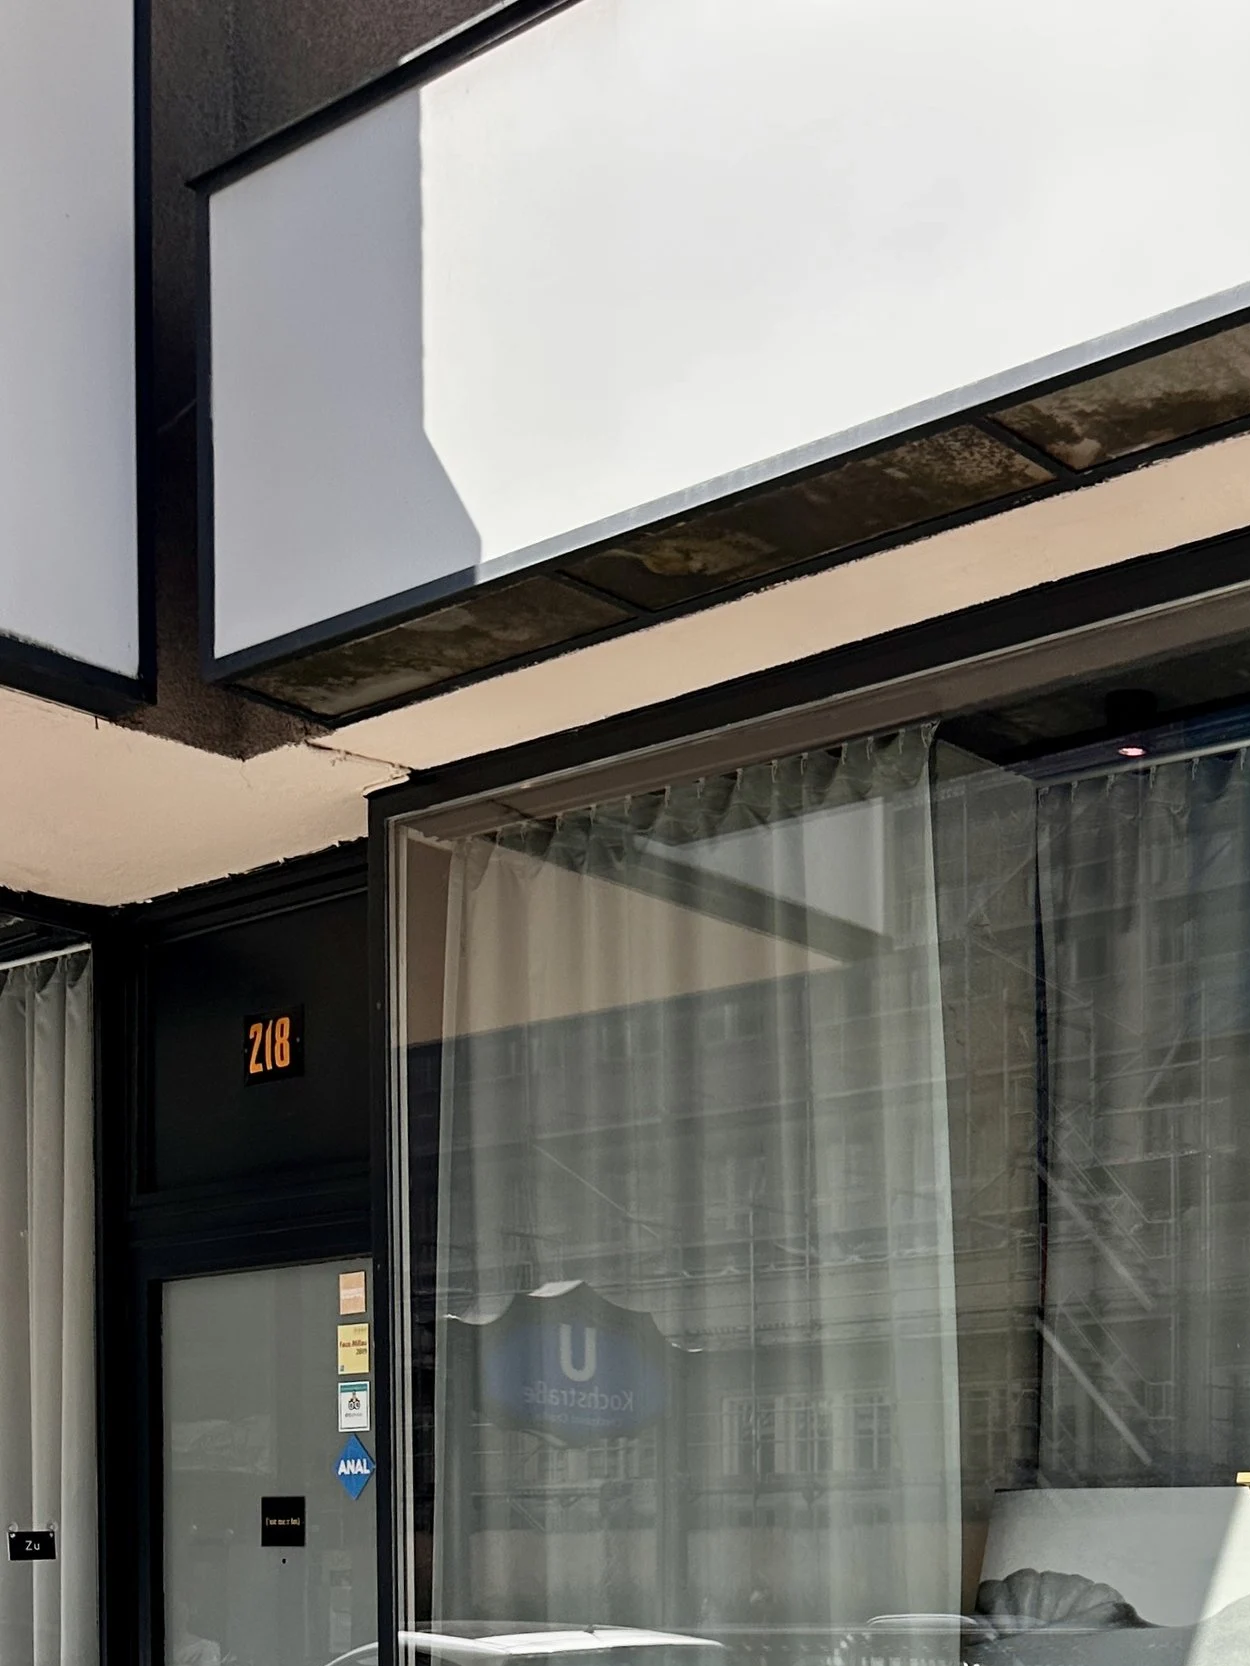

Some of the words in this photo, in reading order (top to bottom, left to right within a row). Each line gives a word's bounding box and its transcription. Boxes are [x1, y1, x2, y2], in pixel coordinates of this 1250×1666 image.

[249, 1017, 290, 1073] 218
[338, 1458, 370, 1475] ANAL
[25, 1540, 40, 1551] Zu
